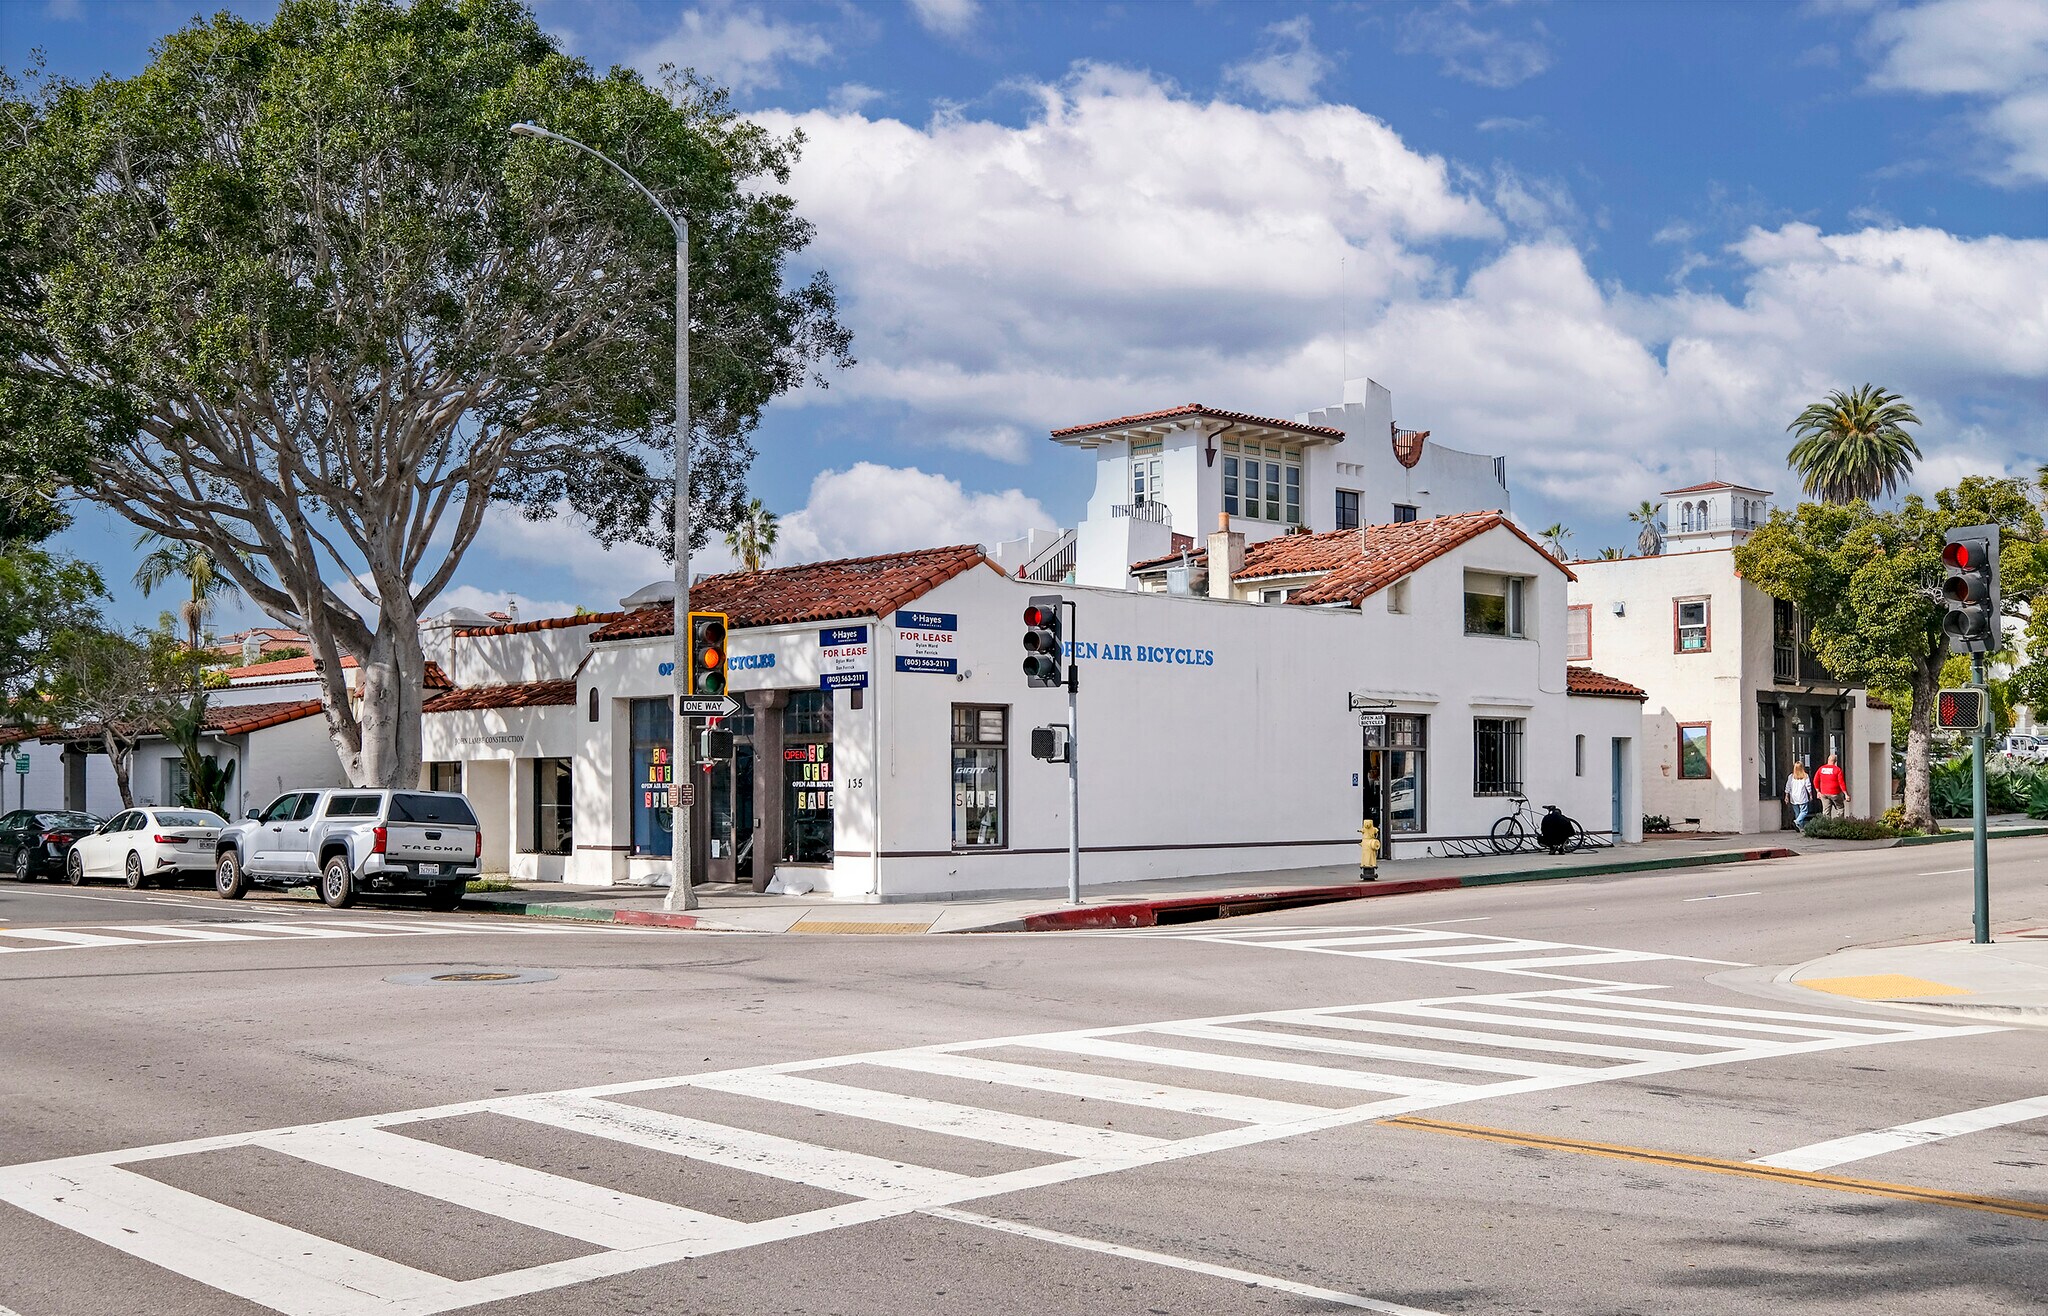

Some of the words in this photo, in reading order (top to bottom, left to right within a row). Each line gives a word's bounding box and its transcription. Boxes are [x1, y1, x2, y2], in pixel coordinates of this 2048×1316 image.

[919, 614, 942, 624] Hayes
[837, 630, 857, 639] Hayes
[900, 632, 919, 641] FOR
[922, 633, 953, 643] LEASE
[823, 649, 839, 658] FOR
[841, 647, 867, 657] LEASE
[1101, 643, 1132, 661] AIR
[1136, 645, 1214, 666] BICYCLES
[727, 653, 776, 671] CYCLES
[904, 658, 921, 667] (805)
[921, 659, 949, 668] 563-2111
[827, 675, 840, 684] (805)
[841, 674, 865, 682] 563-2111
[685, 702, 702, 711] ONE
[705, 702, 722, 711] WAY
[485, 735, 525, 743] CONSTRUCTION
[784, 750, 806, 760] OPEN
[651, 767, 670, 780] OFF
[804, 764, 827, 779] OFF
[848, 778, 863, 789] 135
[799, 793, 833, 808] SALE
[956, 793, 994, 807] SALE
